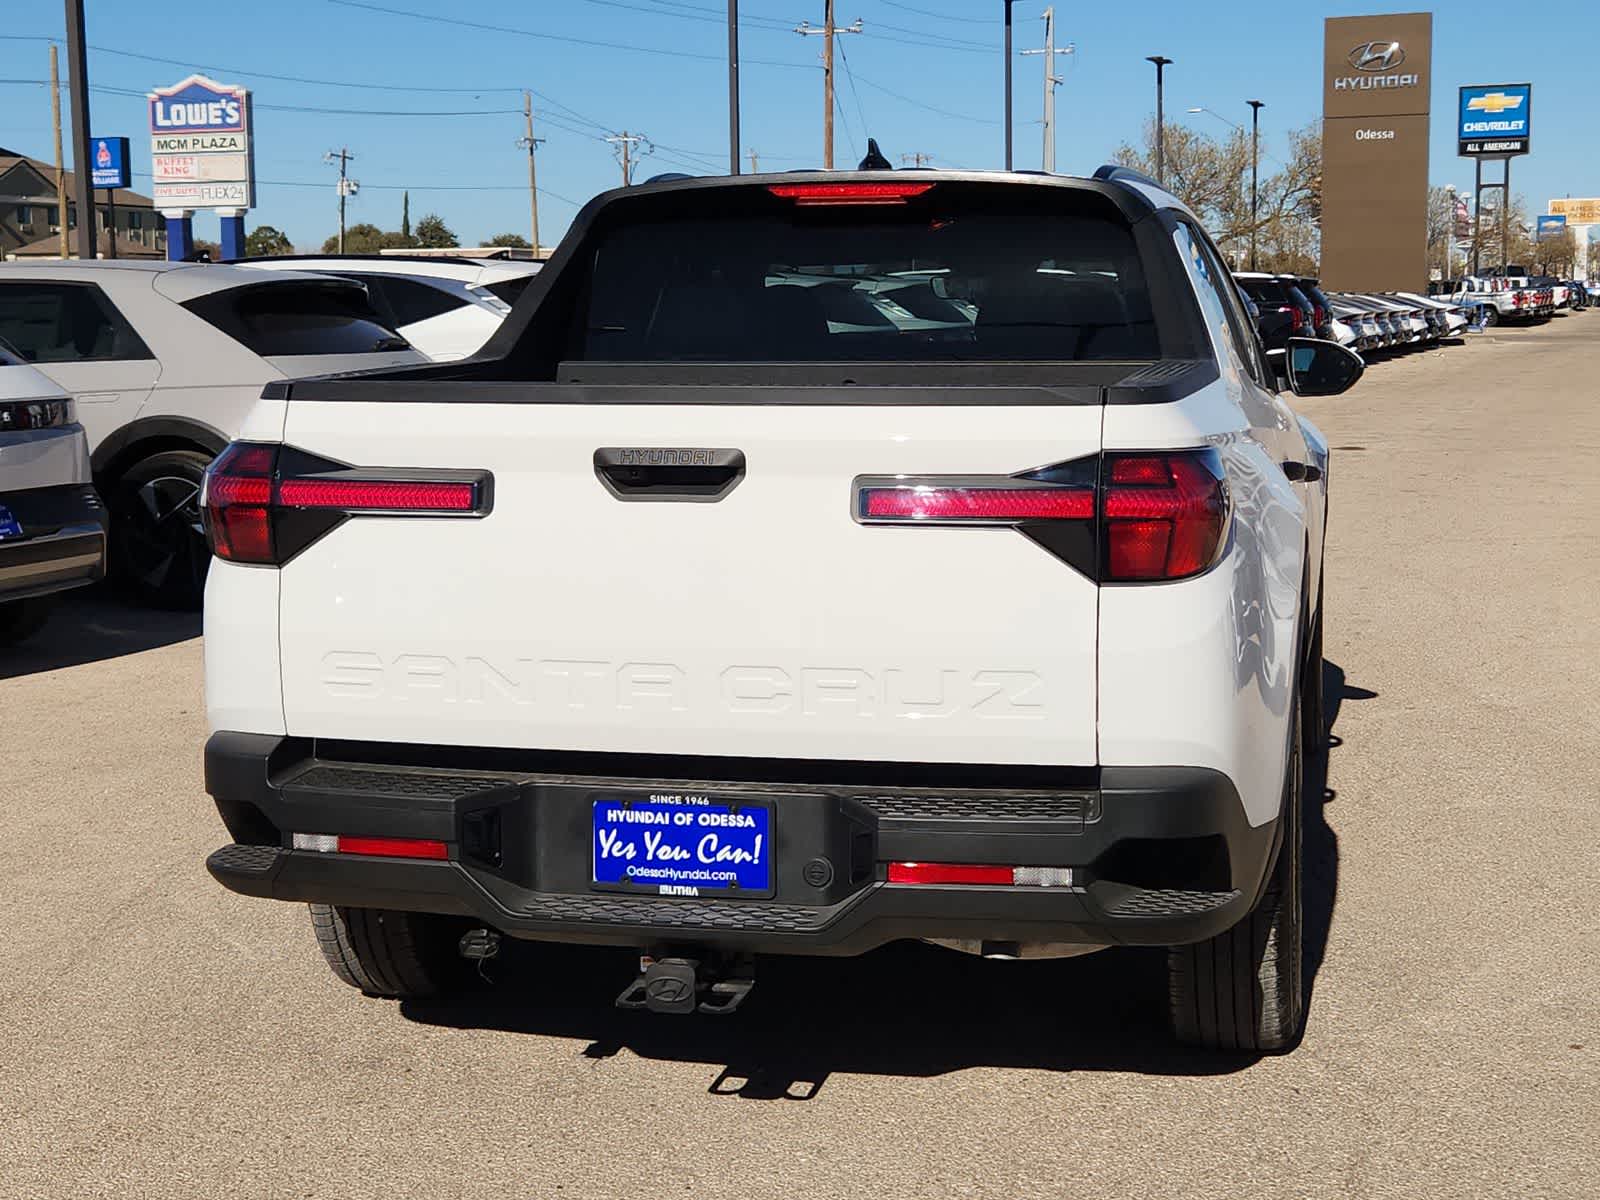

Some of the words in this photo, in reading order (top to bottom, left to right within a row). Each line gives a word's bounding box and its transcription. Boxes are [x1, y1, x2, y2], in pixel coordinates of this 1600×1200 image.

[1334, 74, 1418, 90] HYUNDAI
[155, 99, 240, 126] LOWE'S
[1463, 120, 1525, 132] CHEVROLET
[1355, 129, 1395, 140] Odessa
[157, 139, 188, 150] MCM
[192, 137, 238, 149] PLAZA
[1466, 143, 1481, 151] ALL
[1482, 141, 1521, 151] AMERICAN
[201, 184, 244, 200] FLEX24
[619, 449, 714, 465] HYUNDAI
[320, 650, 689, 712] SANTA
[719, 665, 1049, 720] CRUZ
[650, 795, 682, 805] SINCE
[684, 796, 710, 806] 1946
[607, 809, 670, 825] HYUNDAI
[673, 812, 694, 826] OF
[698, 814, 756, 828] ODESSA
[599, 828, 637, 860] Yes
[644, 831, 691, 861] You
[697, 833, 763, 864] Can!
[626, 865, 737, 881] OdessaHyundai.com
[667, 886, 699, 896] LITHIA
